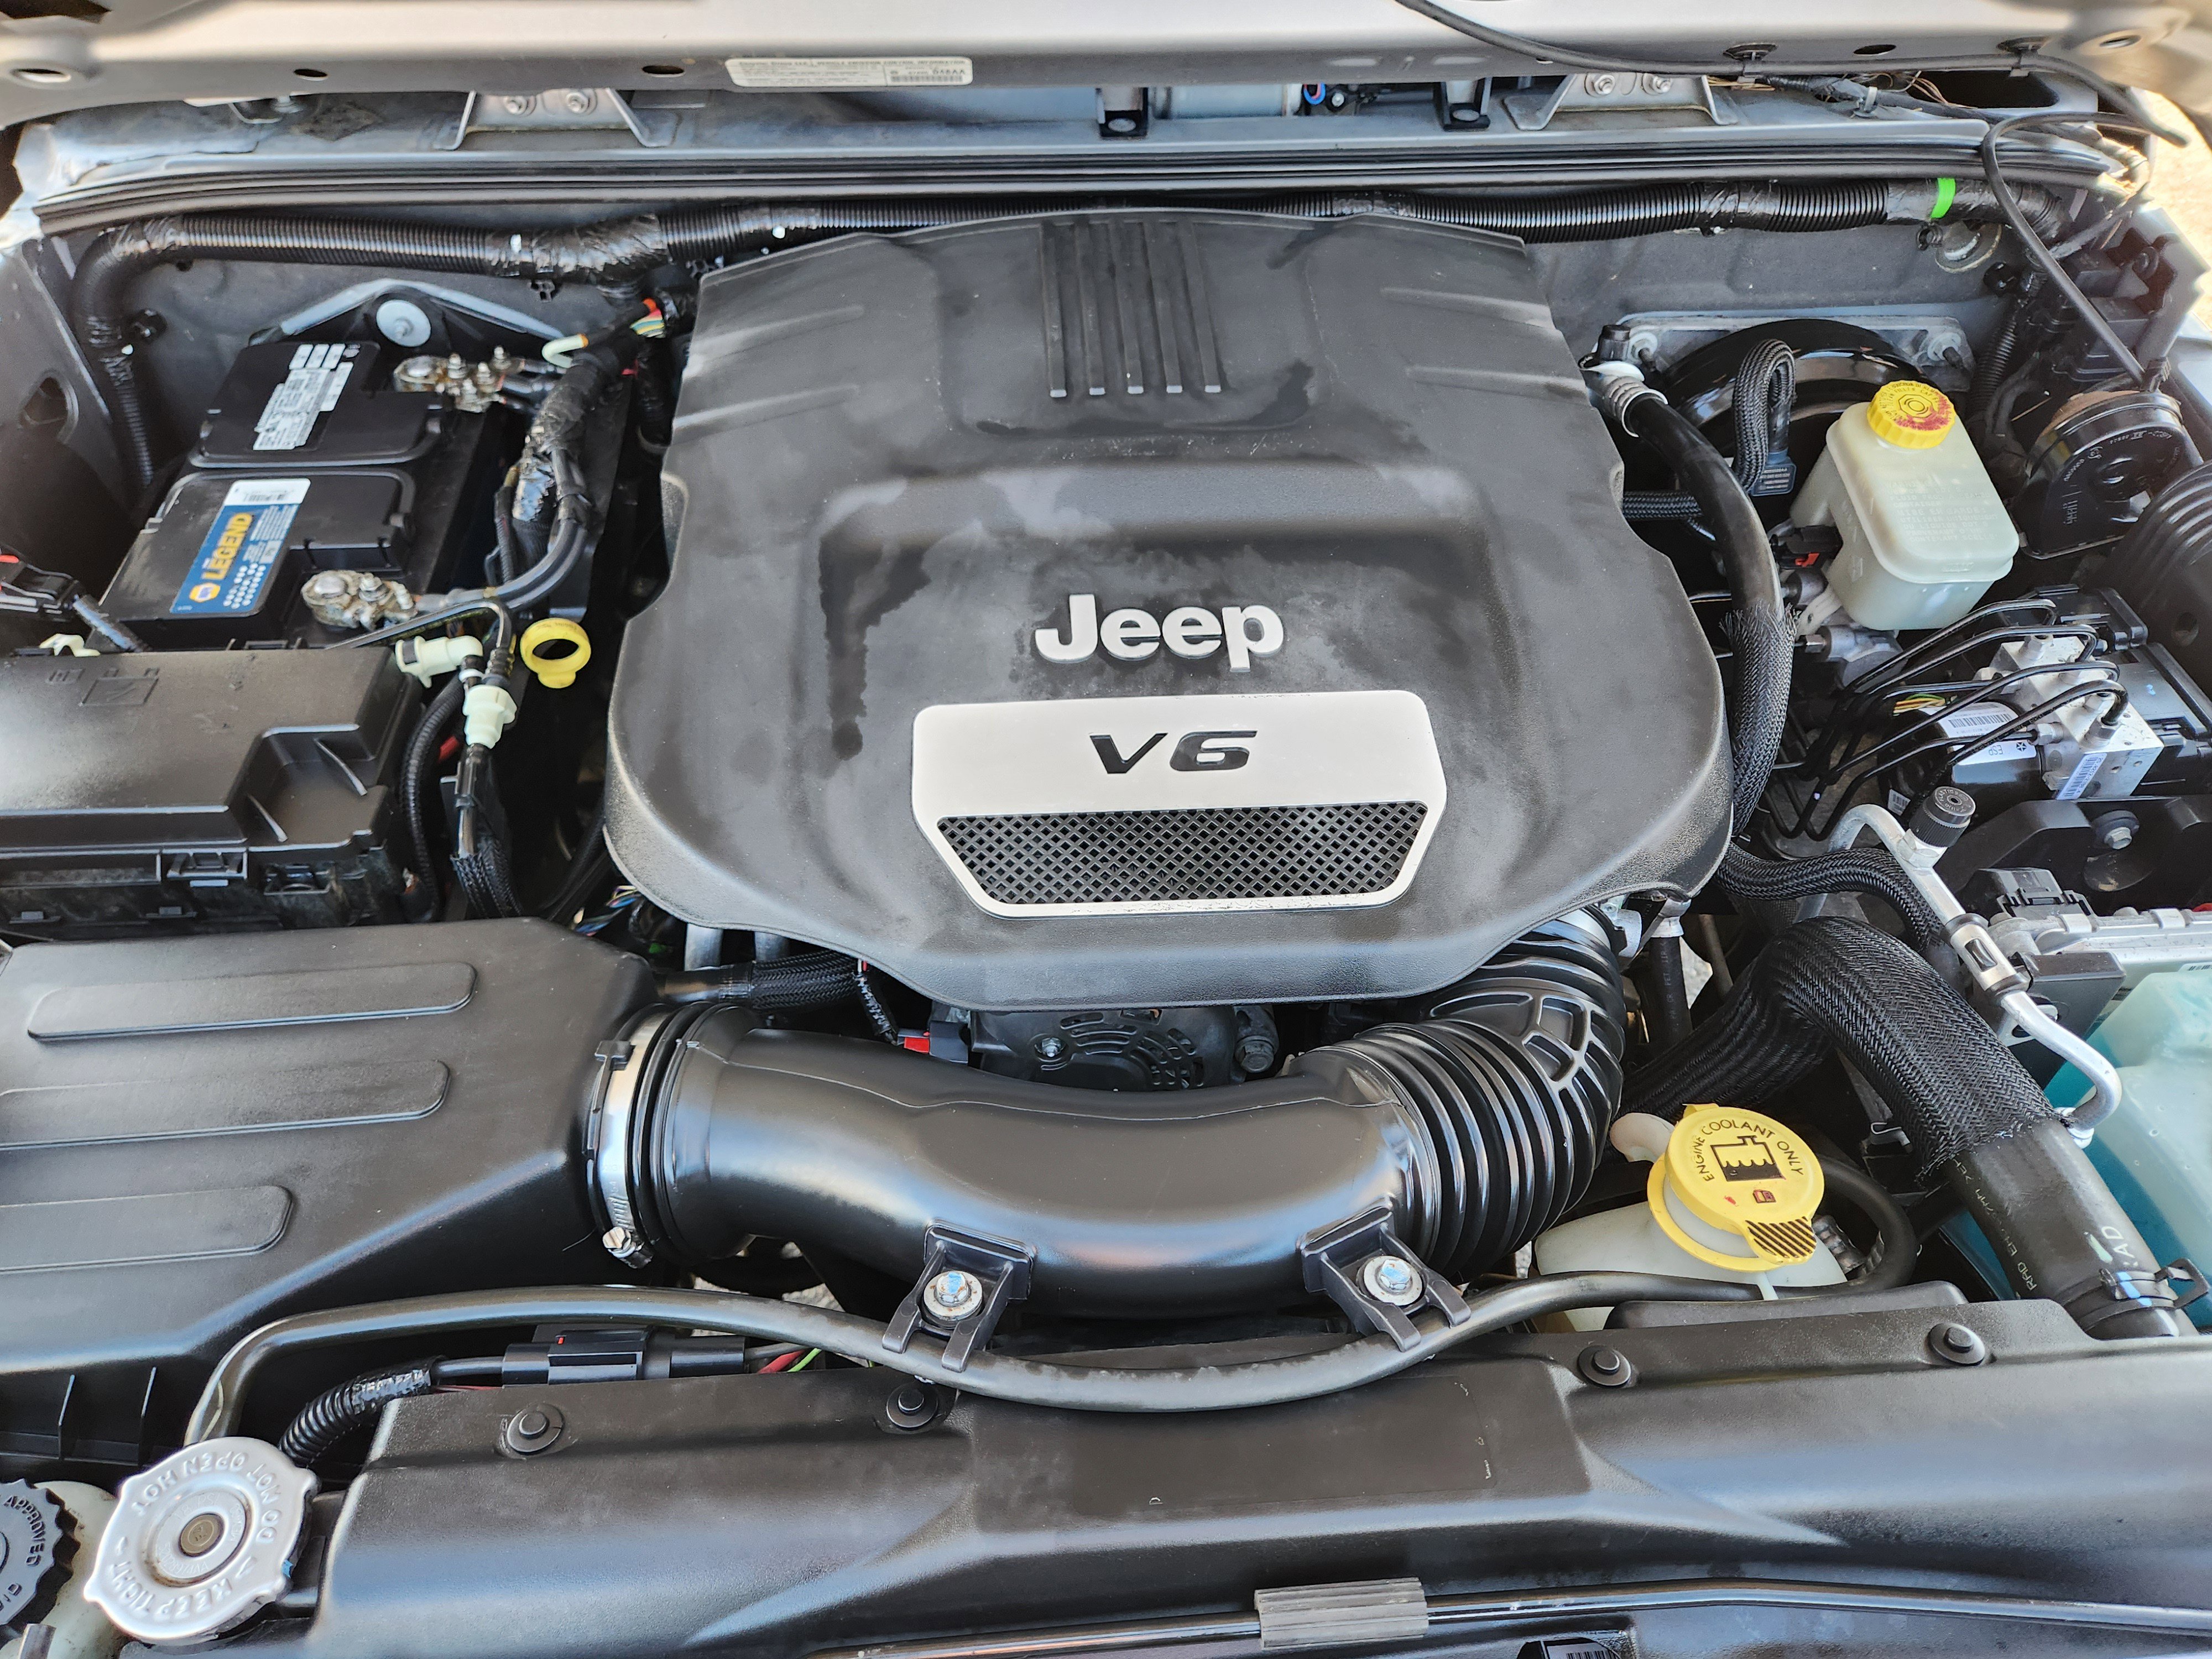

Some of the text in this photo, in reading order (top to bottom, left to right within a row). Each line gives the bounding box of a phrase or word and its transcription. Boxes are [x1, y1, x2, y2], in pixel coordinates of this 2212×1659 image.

[201, 512, 254, 580] LEGEND
[1034, 594, 1284, 672] Jeep
[1089, 730, 1258, 775] V6
[1988, 744, 2004, 755] ESP
[1692, 1119, 1804, 1182] ENGINE COOLANT ONLY
[2101, 1226, 2138, 1267] AD
[2017, 1261, 2037, 1291] RAD
[182, 1451, 249, 1475] OPEN
[247, 1463, 282, 1505] NOT
[132, 1468, 179, 1517] HOT
[196, 1493, 221, 1509] PSI
[2, 1495, 46, 1567] APPROVED
[255, 1509, 283, 1545] DO
[107, 1559, 234, 1621] KEEP TIGHT
